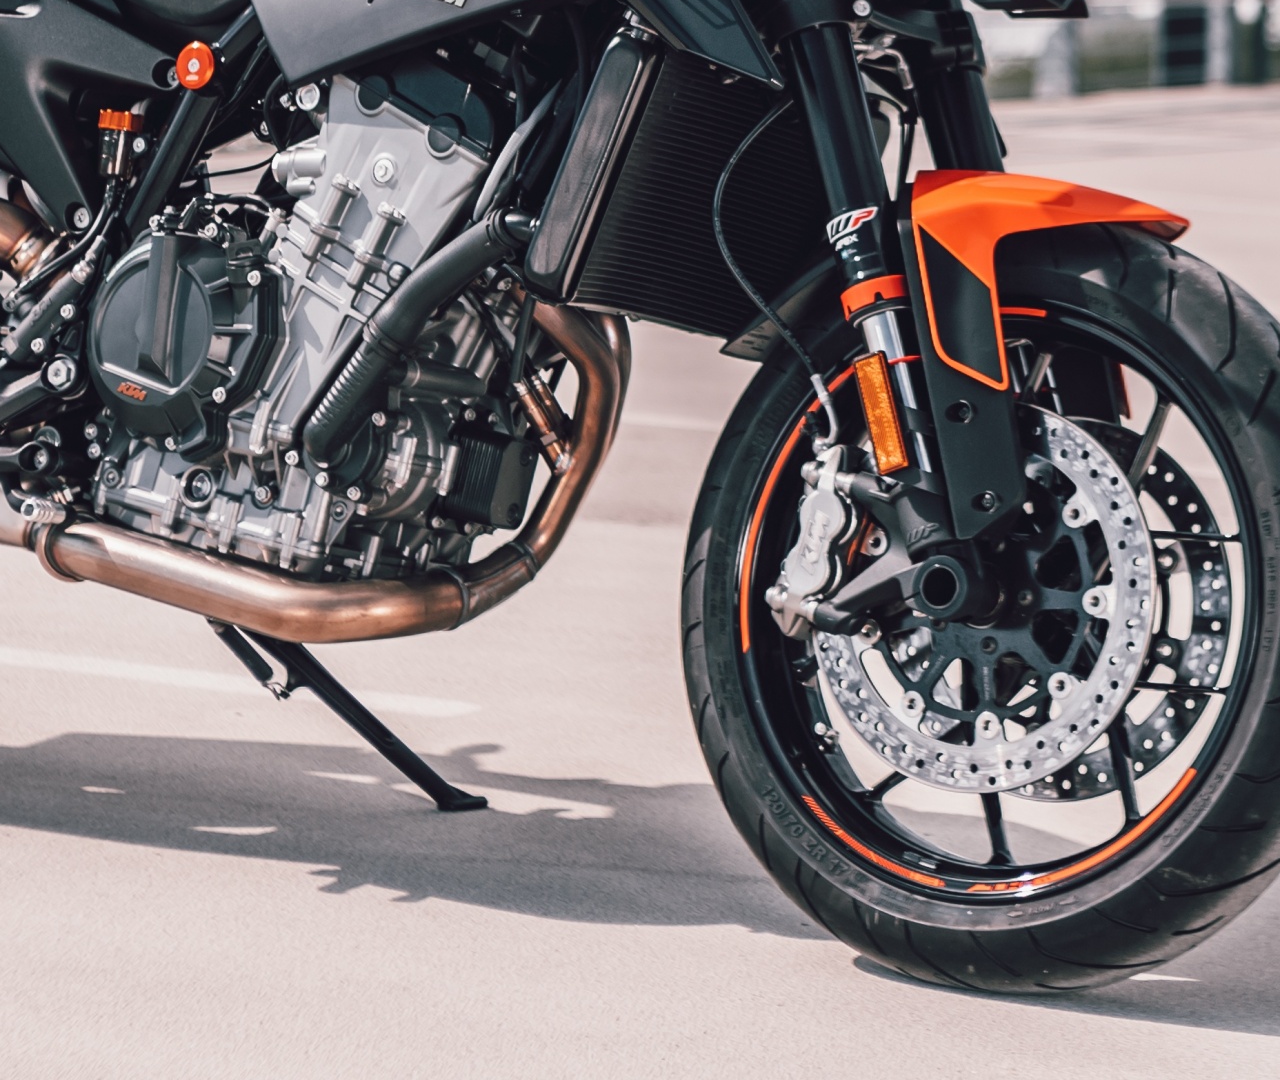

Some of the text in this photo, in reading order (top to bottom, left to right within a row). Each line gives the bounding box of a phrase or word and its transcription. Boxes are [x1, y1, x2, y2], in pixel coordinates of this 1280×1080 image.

[826, 206, 878, 244] WP
[116, 381, 147, 401] KTM
[762, 785, 850, 877] 120/70 ZR 17
